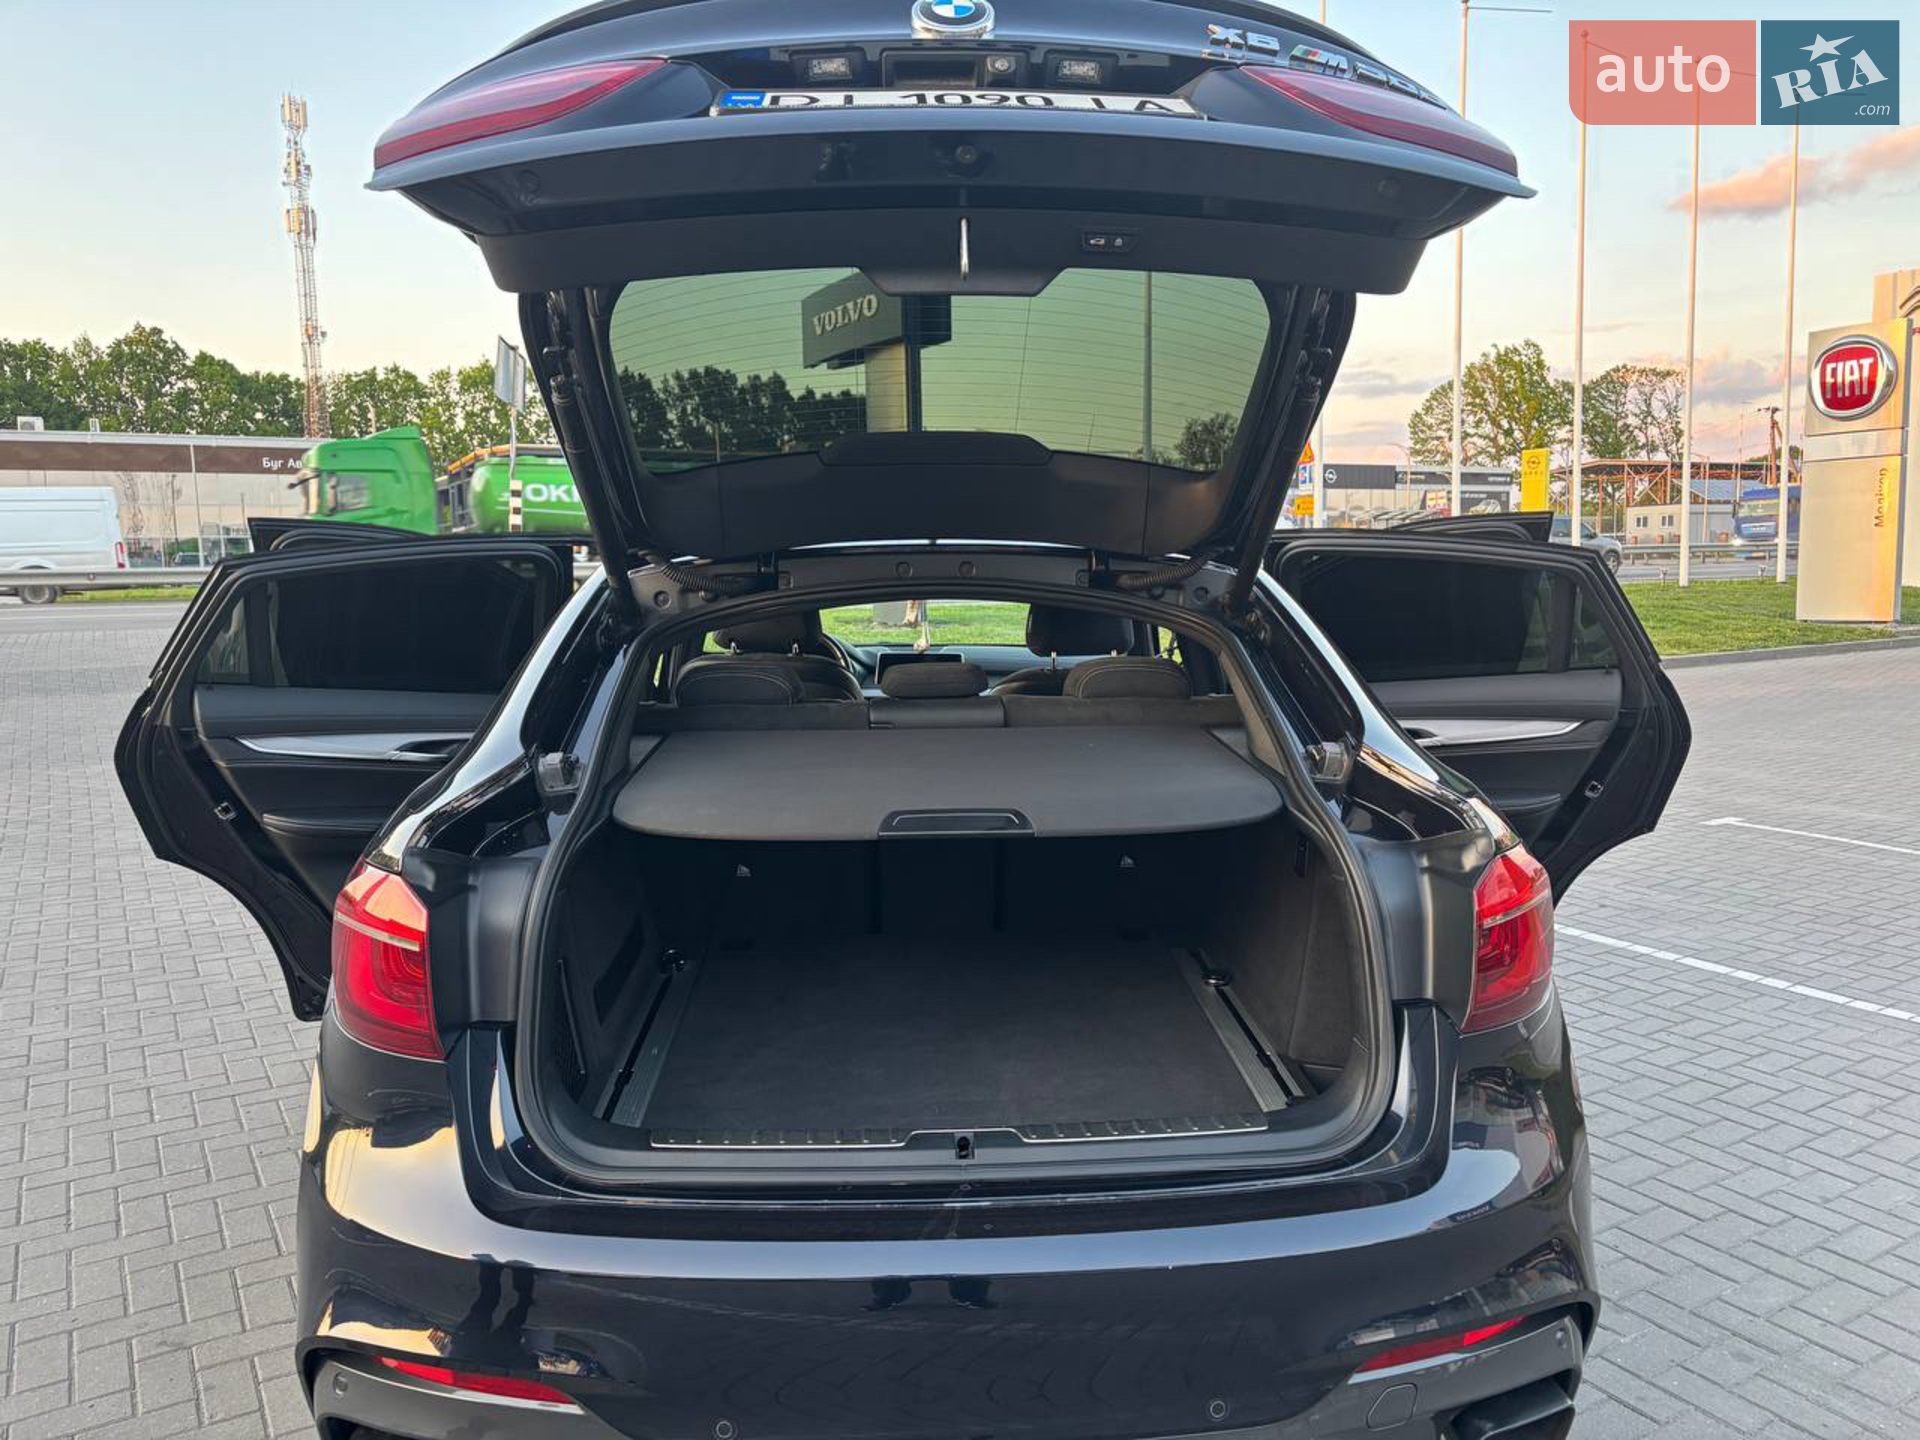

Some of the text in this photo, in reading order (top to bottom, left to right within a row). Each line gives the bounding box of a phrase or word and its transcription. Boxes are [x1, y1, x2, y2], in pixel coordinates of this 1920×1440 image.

[769, 94, 853, 106] DI
[899, 93, 1054, 106] 1090
[1091, 97, 1174, 112] IA
[813, 294, 878, 336] VOLVO
[1825, 357, 1875, 399] FIAT
[262, 457, 284, 470] Буг
